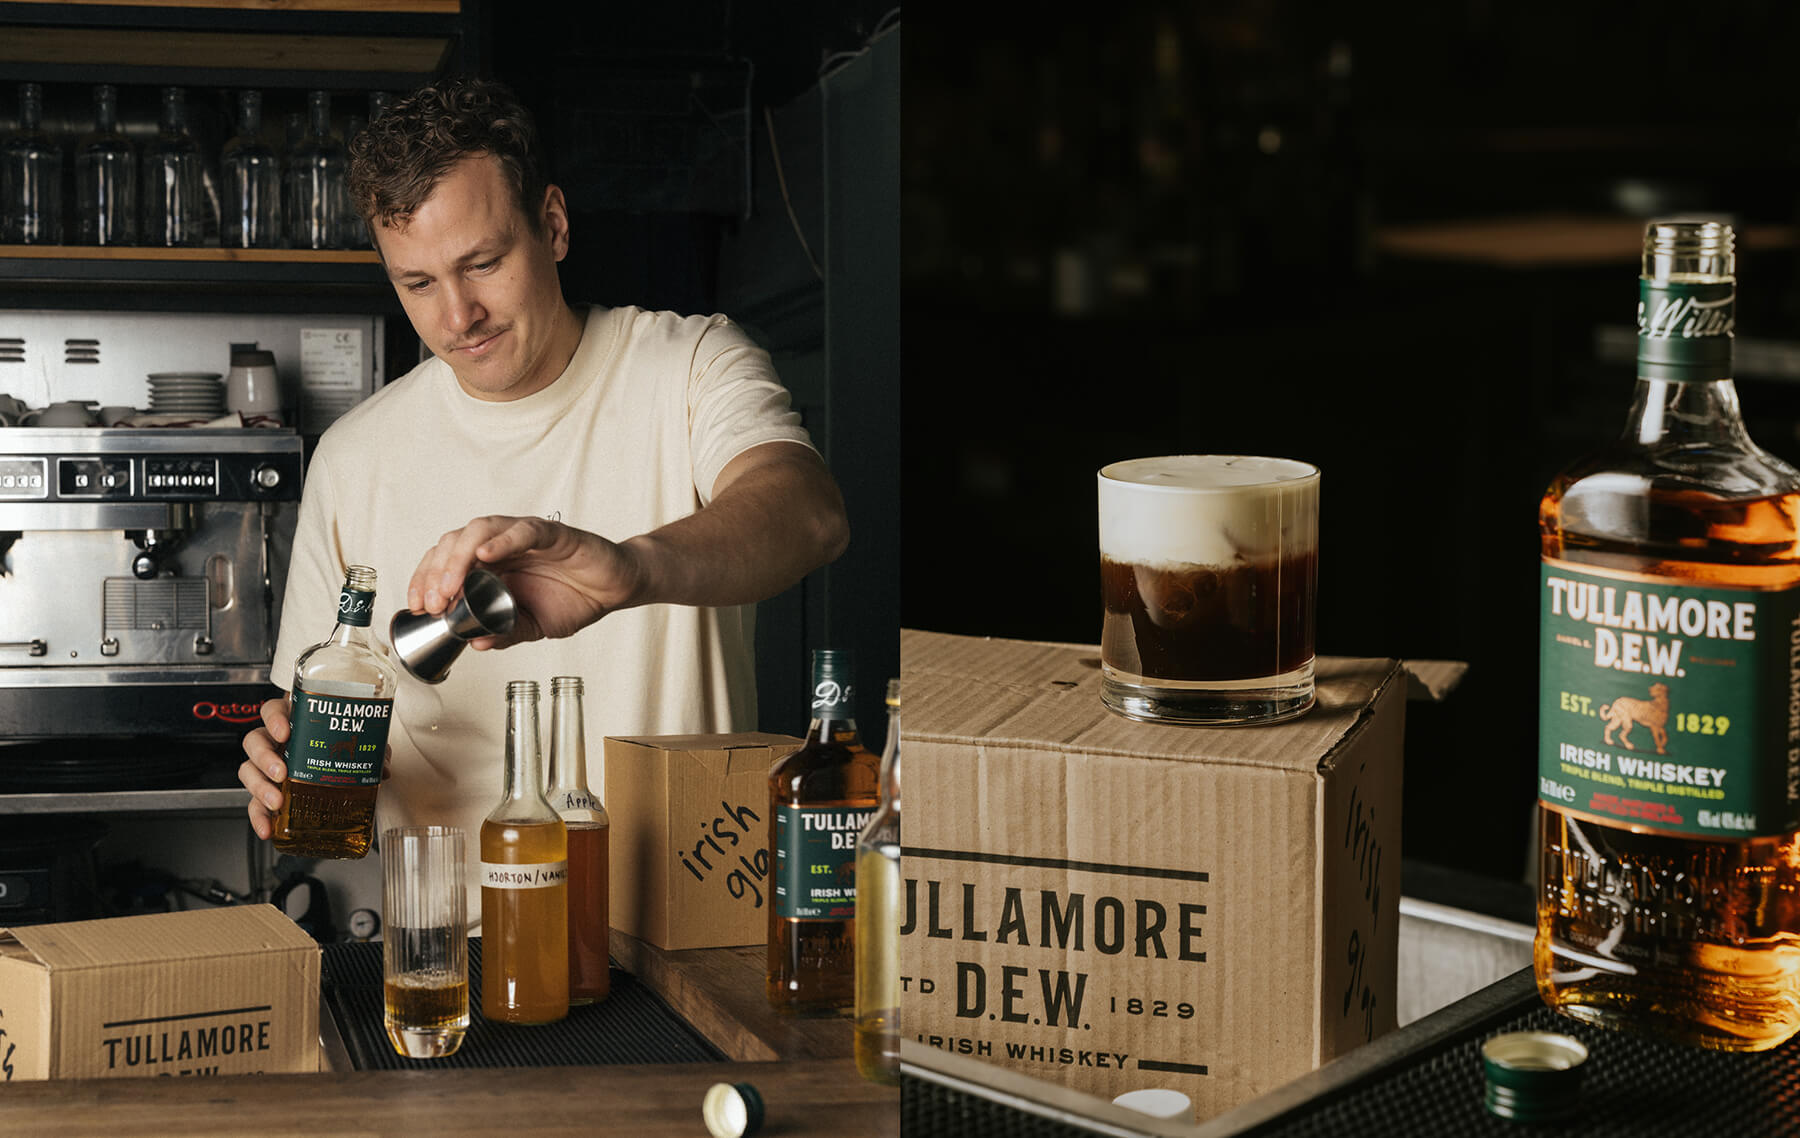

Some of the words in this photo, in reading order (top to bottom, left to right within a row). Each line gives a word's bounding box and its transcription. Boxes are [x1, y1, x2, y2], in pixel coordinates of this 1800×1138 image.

[1547, 576, 1757, 641] TULLAMORE
[1594, 626, 1686, 678] D.E.W.
[307, 697, 391, 719] TULLAMORE
[328, 716, 365, 733] D.E.W.
[1560, 690, 1596, 717] EST.
[1676, 712, 1731, 736] 1829
[306, 758, 333, 768] IRISH
[333, 761, 374, 770] WHISKEY
[308, 739, 328, 749] EST.
[358, 743, 377, 752] 1829
[1559, 742, 1612, 772] IRISH
[1616, 755, 1728, 788] WHISKEY
[677, 800, 762, 883] irish
[831, 832, 862, 850] D.E.
[810, 864, 833, 875] EST.
[810, 888, 841, 898] IRISH
[955, 961, 1092, 1032] D.E.W.
[1109, 996, 1196, 1020] 1829
[103, 1021, 272, 1070] TULLAMORE
[917, 1034, 993, 1058] IRISH
[1005, 1042, 1130, 1071] WHISKEY
